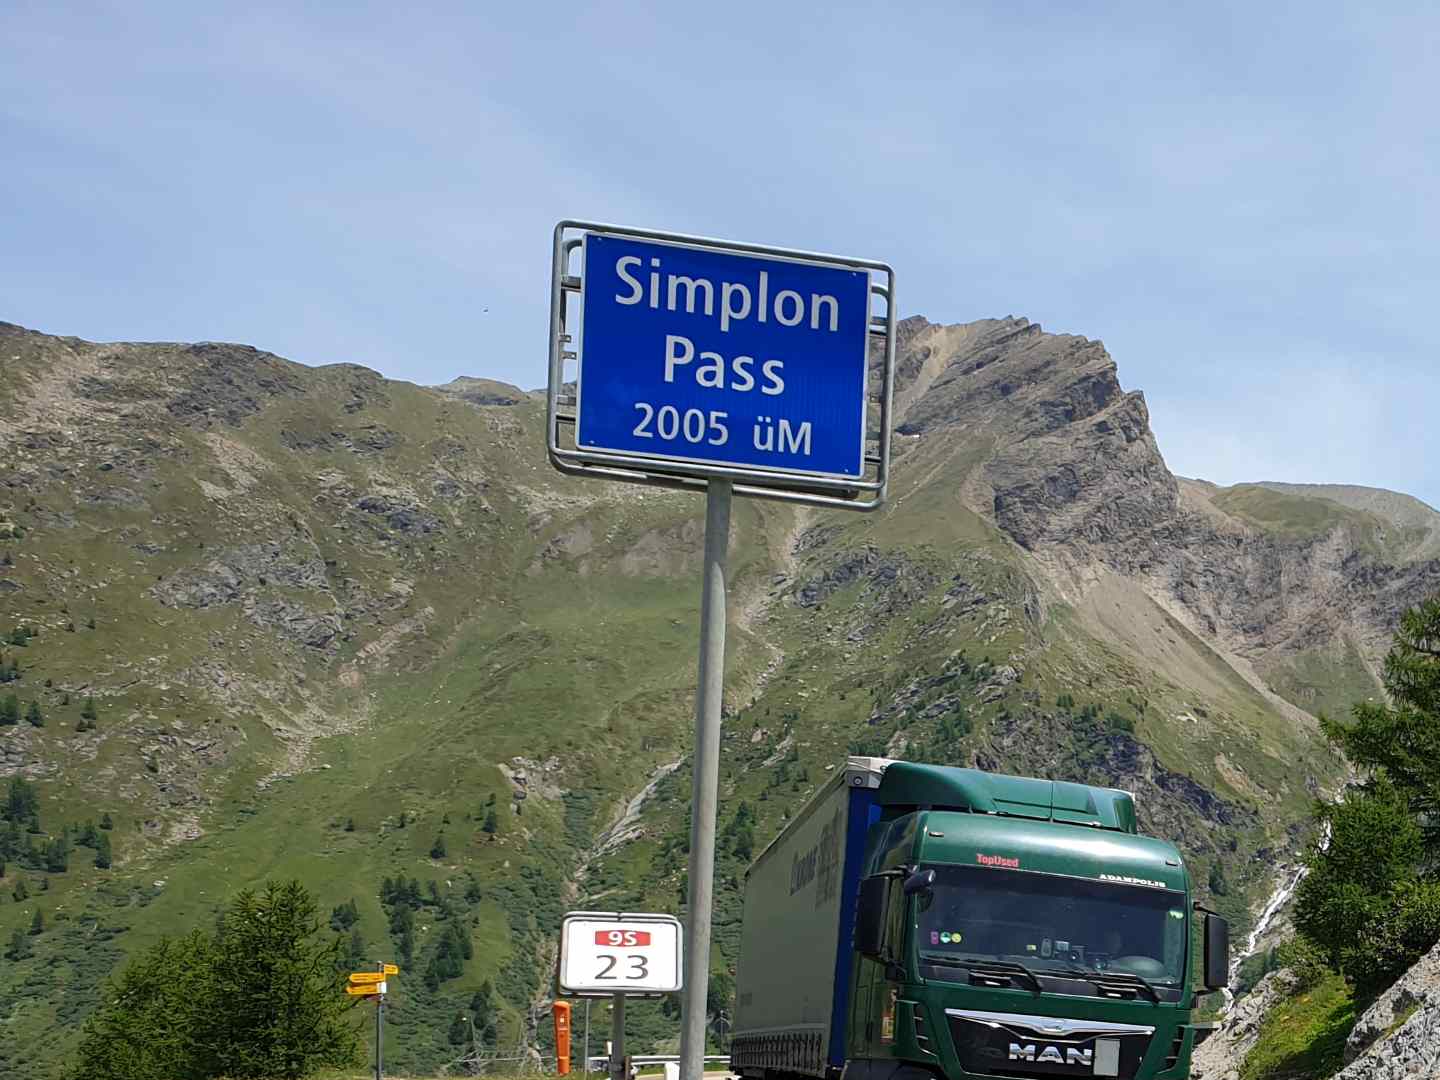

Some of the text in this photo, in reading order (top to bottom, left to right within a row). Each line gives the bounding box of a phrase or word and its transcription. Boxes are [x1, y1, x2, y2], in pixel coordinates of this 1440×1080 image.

[615, 256, 839, 331] Simplon
[664, 335, 785, 395] Pass
[632, 402, 812, 456] 2005 üM
[594, 955, 648, 980] 23
[1008, 1043, 1092, 1066] MAN
